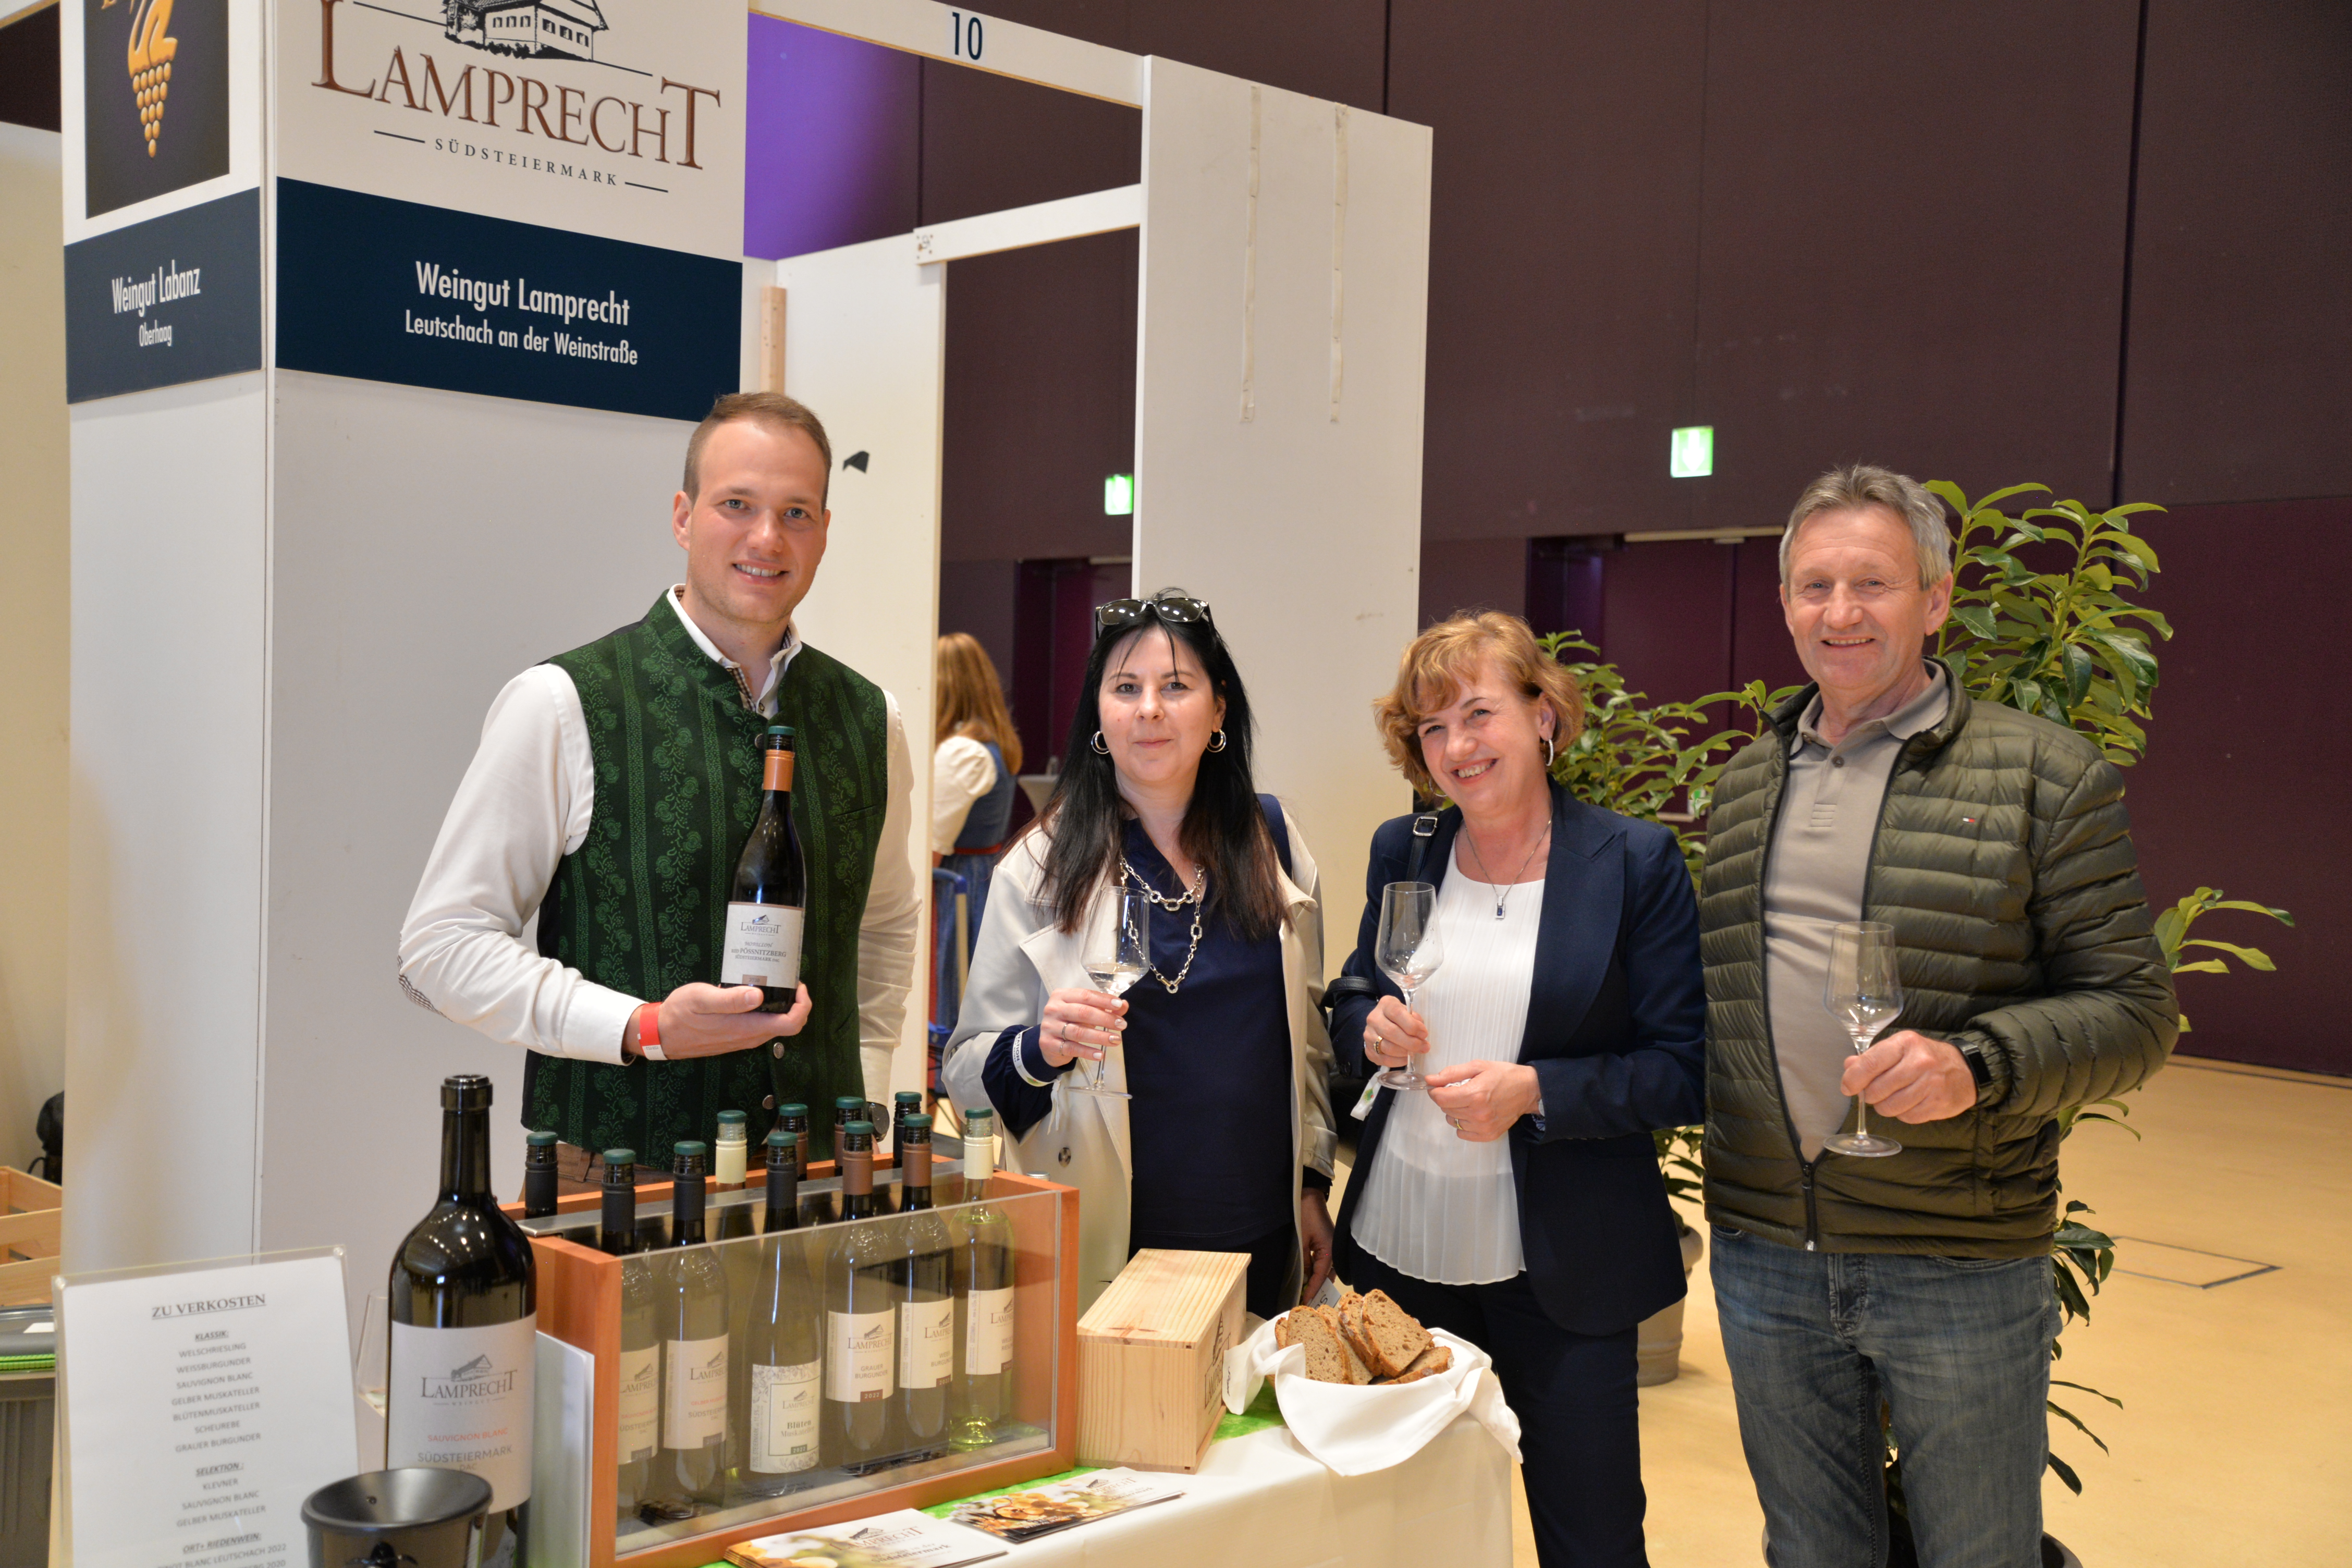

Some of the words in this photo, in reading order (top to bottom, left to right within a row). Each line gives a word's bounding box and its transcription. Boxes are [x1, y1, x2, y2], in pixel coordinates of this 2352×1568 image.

[952, 11, 983, 60] 10
[311, 0, 721, 170] LAMPRECHT
[435, 138, 618, 187] SÜDSTEIERMARK
[112, 273, 156, 317] Weingut
[159, 259, 201, 303] Labanz
[416, 261, 510, 312] Weingut
[519, 278, 630, 326] Lamprecht
[139, 319, 173, 347] Oberhaag
[406, 309, 493, 345] Leutschach
[498, 329, 518, 348] an
[523, 326, 549, 352] der
[554, 332, 638, 365] Weinstraße
[740, 922, 781, 934] LAMPRECHT
[152, 1305, 172, 1318] ZU
[176, 1294, 266, 1315] VERKOSTEN
[195, 1330, 229, 1341] KLASSIK:
[848, 1332, 893, 1350] LAMPRECHT
[179, 1343, 247, 1358] WELSCHRIESLING
[176, 1357, 251, 1374] WEISSBURGUNDER
[855, 1369, 888, 1379] BURGUNDER
[861, 1364, 884, 1372] GRAUER
[176, 1376, 225, 1390] SAUVIGNON
[227, 1372, 253, 1382] BLANC
[421, 1369, 518, 1399] LAMPRECHT
[172, 1395, 203, 1406] GELBER
[204, 1386, 260, 1401] MUSKATELLER
[782, 1395, 815, 1410] LAMPRECHT
[173, 1401, 260, 1422] BLÜTENMUSKATELLER
[194, 1420, 241, 1434] SCHEUREBE
[781, 1426, 816, 1438] Muskateller
[787, 1419, 812, 1430] Blüten
[175, 1441, 209, 1453] GRAUER
[211, 1432, 262, 1447] BURGUNDER
[427, 1433, 481, 1442] SAUVIGNON
[482, 1428, 508, 1439] BLANC
[418, 1445, 513, 1463] SÜDSTEIERMARK
[195, 1462, 240, 1477] SELEKTION
[459, 1463, 477, 1472] DAC
[202, 1478, 239, 1490] KLEVNER
[182, 1494, 231, 1510] SAUVIGNON
[234, 1490, 260, 1502] BLANC
[176, 1514, 207, 1528] GELBER
[209, 1505, 266, 1522] MUSKATELLER
[829, 1526, 925, 1551] LAMPRECHT
[213, 1547, 266, 1564] LEUTSCHACH
[268, 1543, 287, 1553] 2022
[871, 1544, 952, 1563] Südsteiermark
